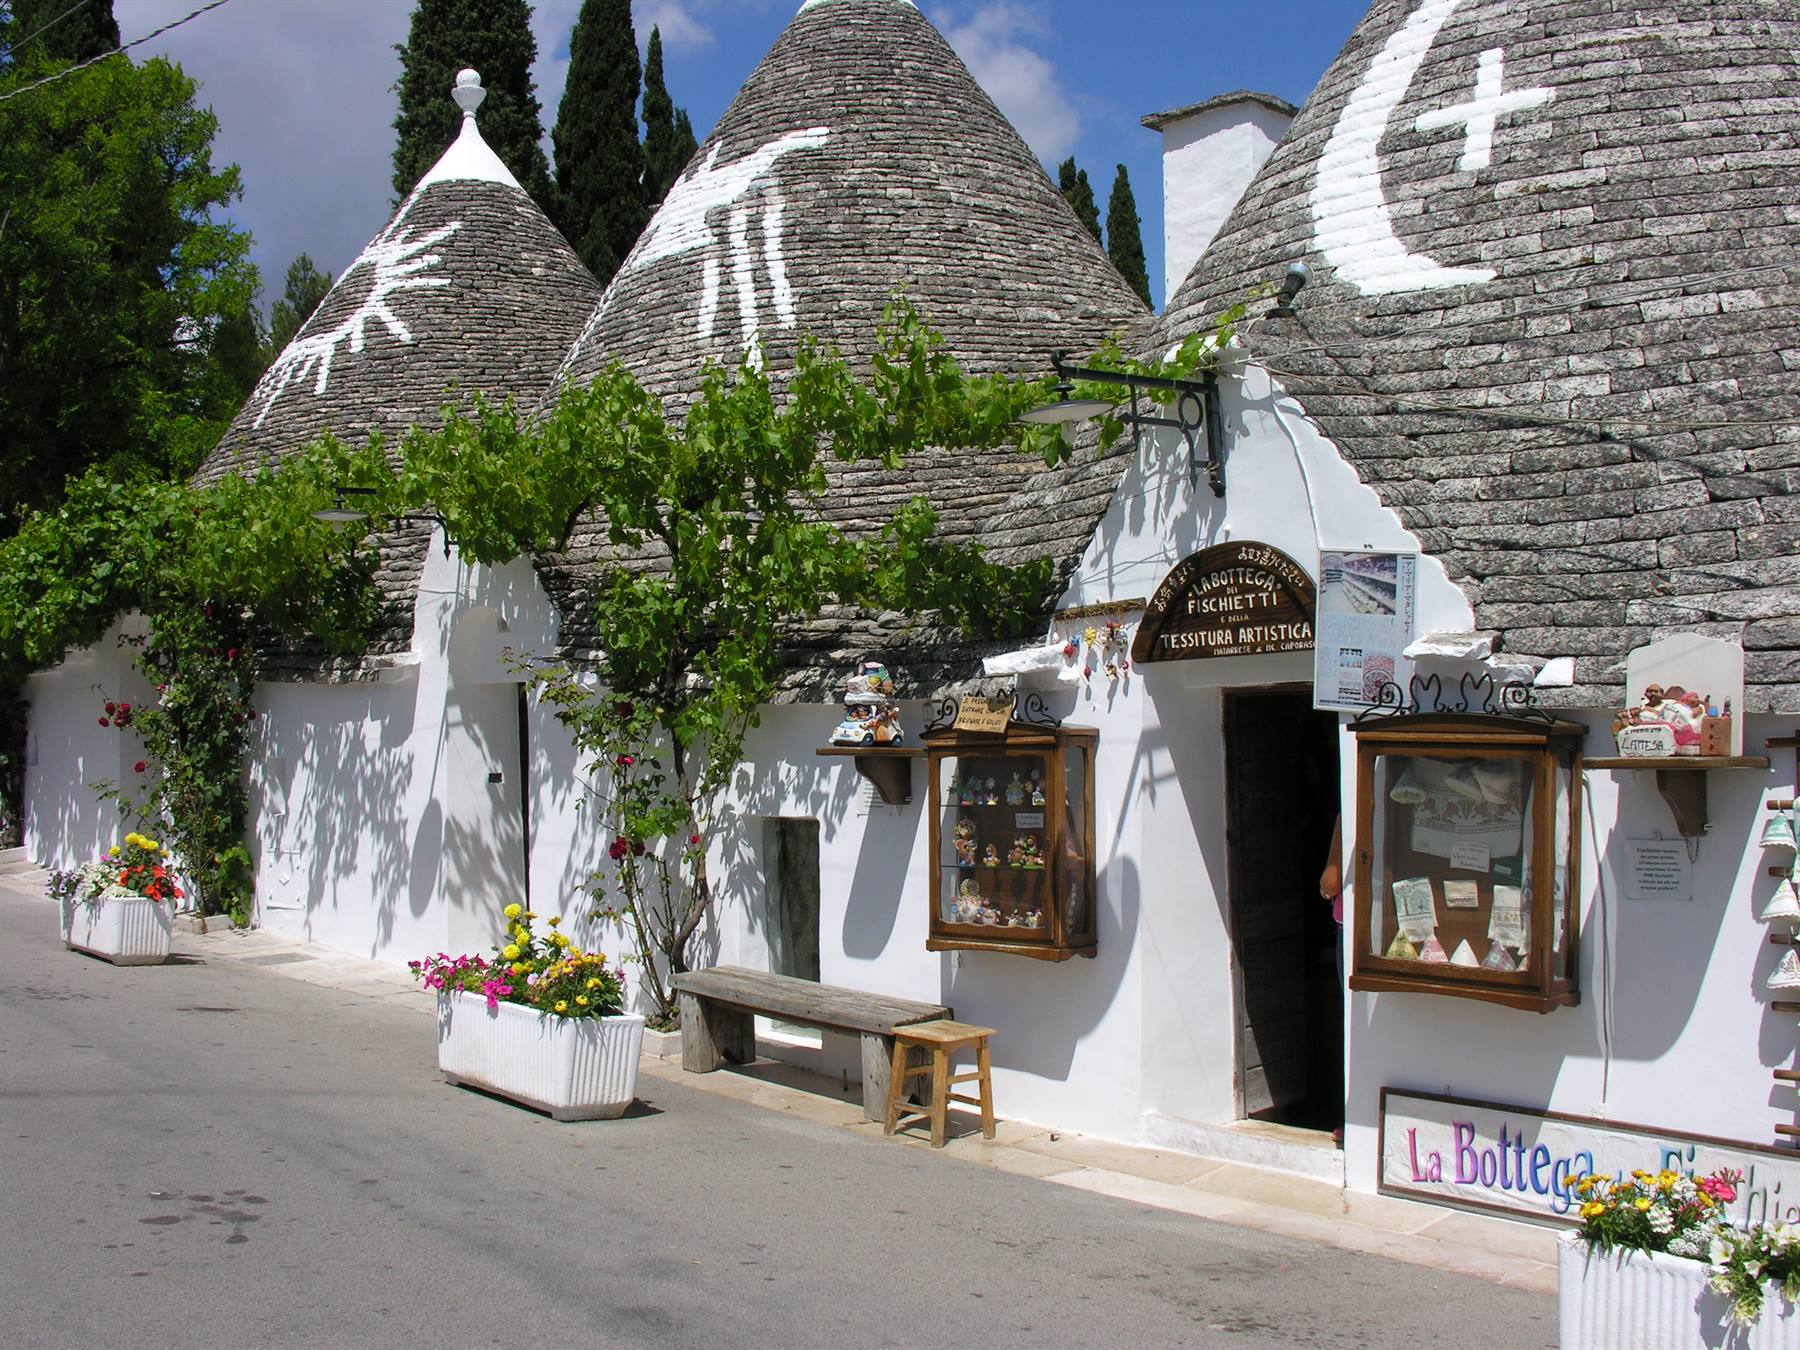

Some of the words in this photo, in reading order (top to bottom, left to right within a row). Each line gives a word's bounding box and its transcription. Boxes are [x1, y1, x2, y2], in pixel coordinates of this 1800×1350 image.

[1226, 587, 1238, 595] DEI
[1188, 592, 1277, 614] FISCHIETTI
[1228, 614, 1249, 623] DELLA
[1160, 628, 1233, 649] TESSITURA
[1239, 622, 1312, 643] ARTISTICA
[1407, 1127, 1442, 1184] La
[1452, 1119, 1593, 1214] Bottega
